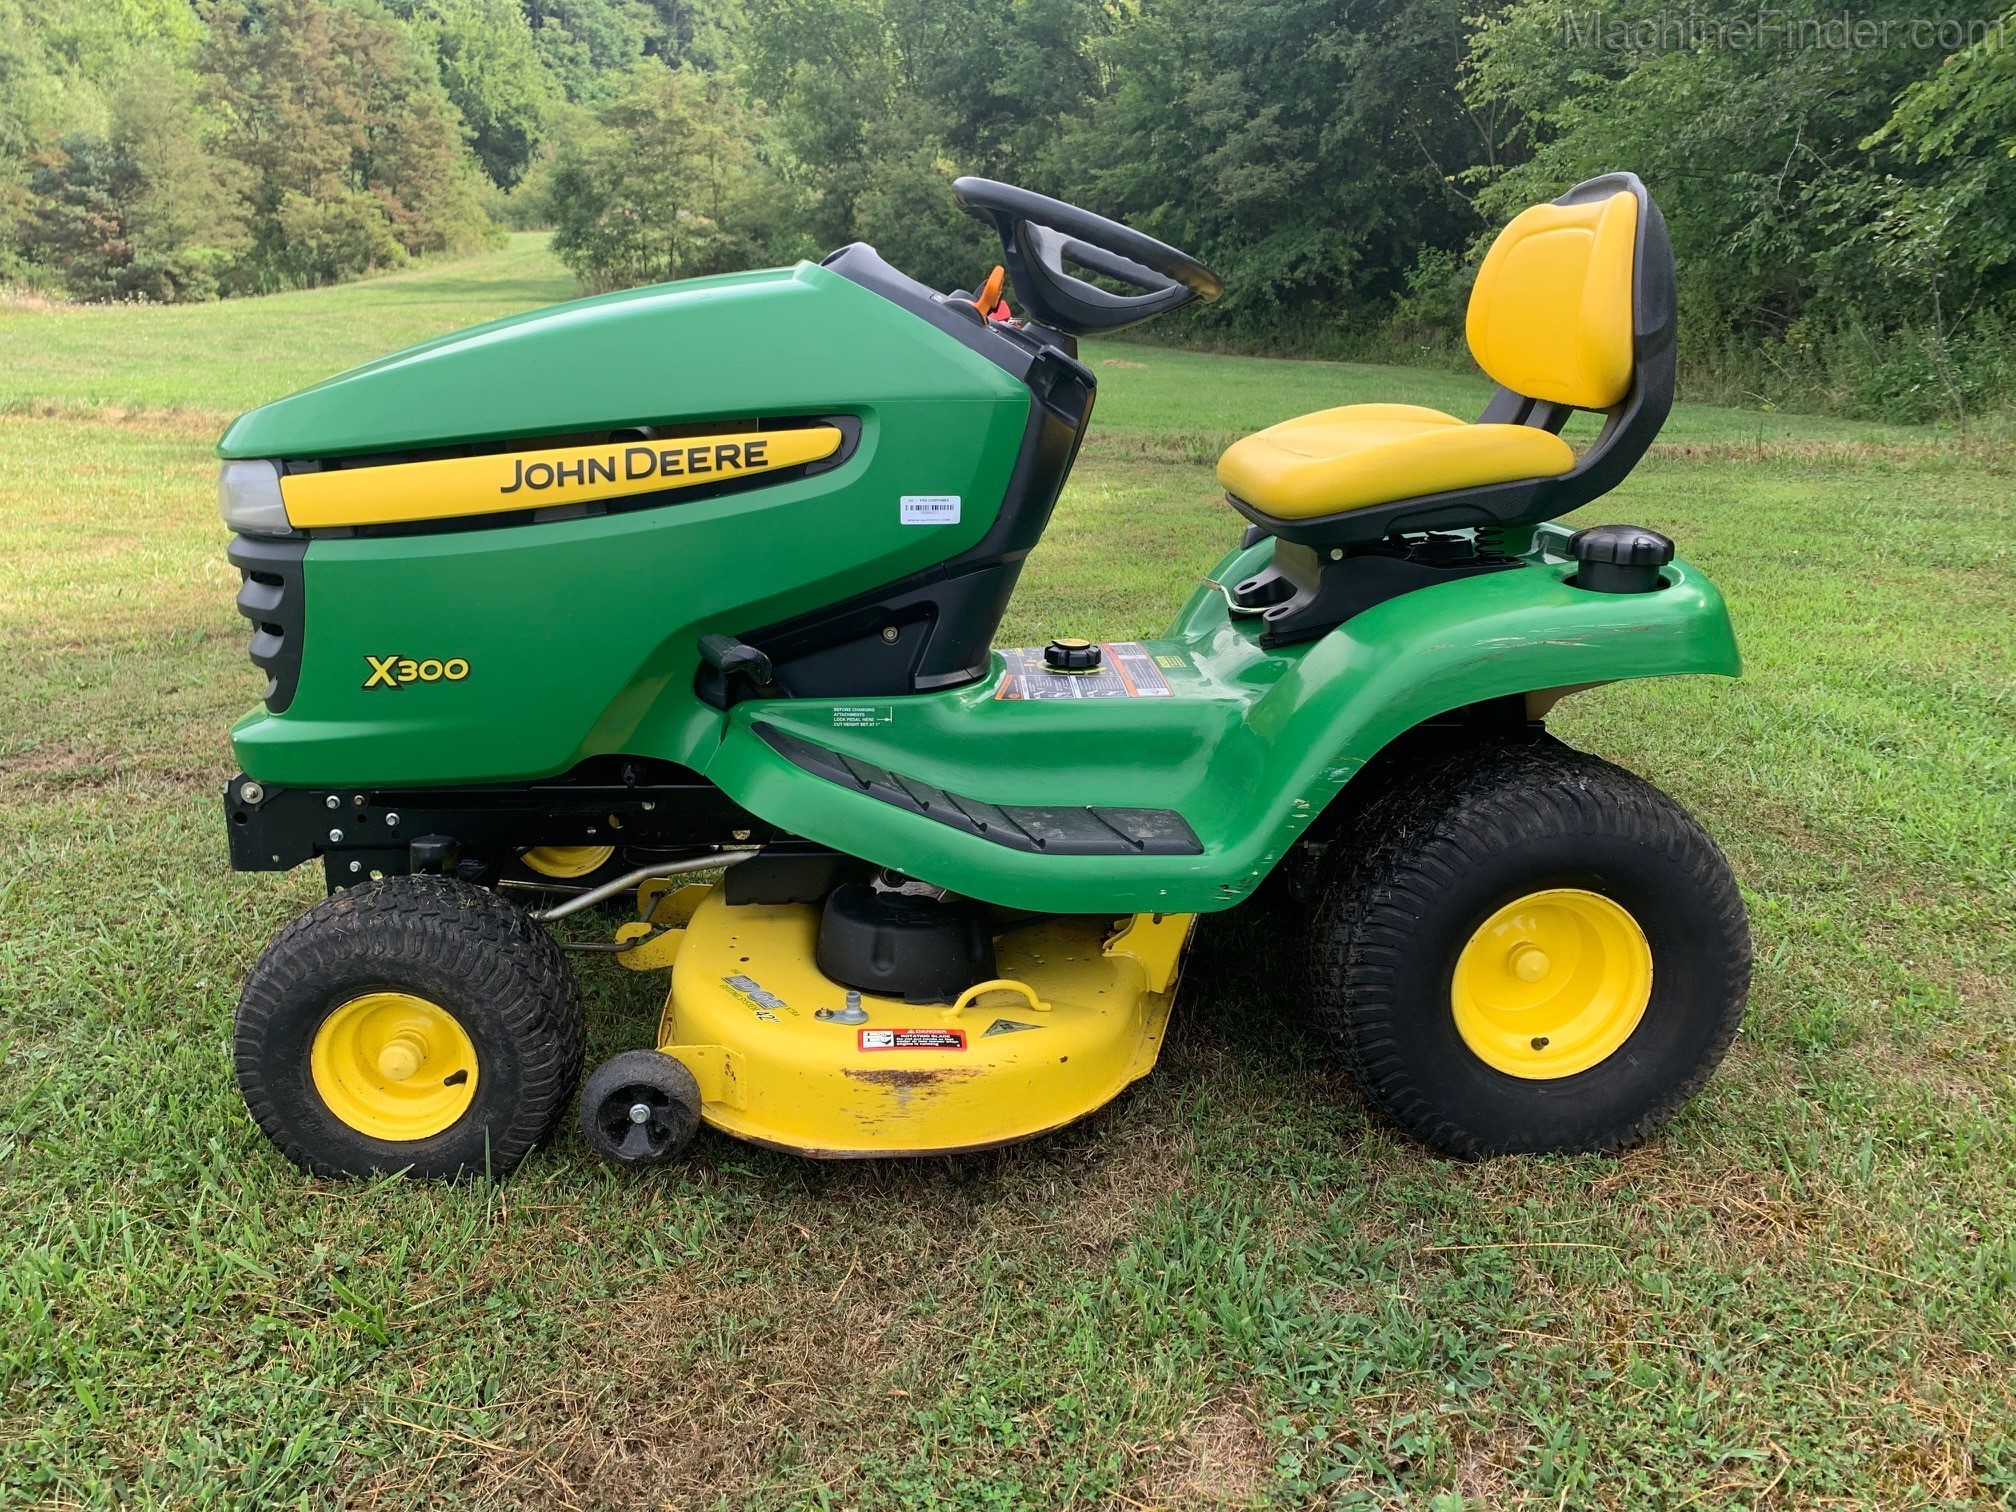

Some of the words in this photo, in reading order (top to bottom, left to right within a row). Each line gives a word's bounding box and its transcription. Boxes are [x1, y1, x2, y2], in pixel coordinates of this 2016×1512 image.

[499, 456, 616, 494] JOHN
[625, 440, 769, 478] DEERE
[362, 654, 470, 690] X300
[721, 974, 788, 1010] EDGE
[756, 1010, 782, 1023] 42"
